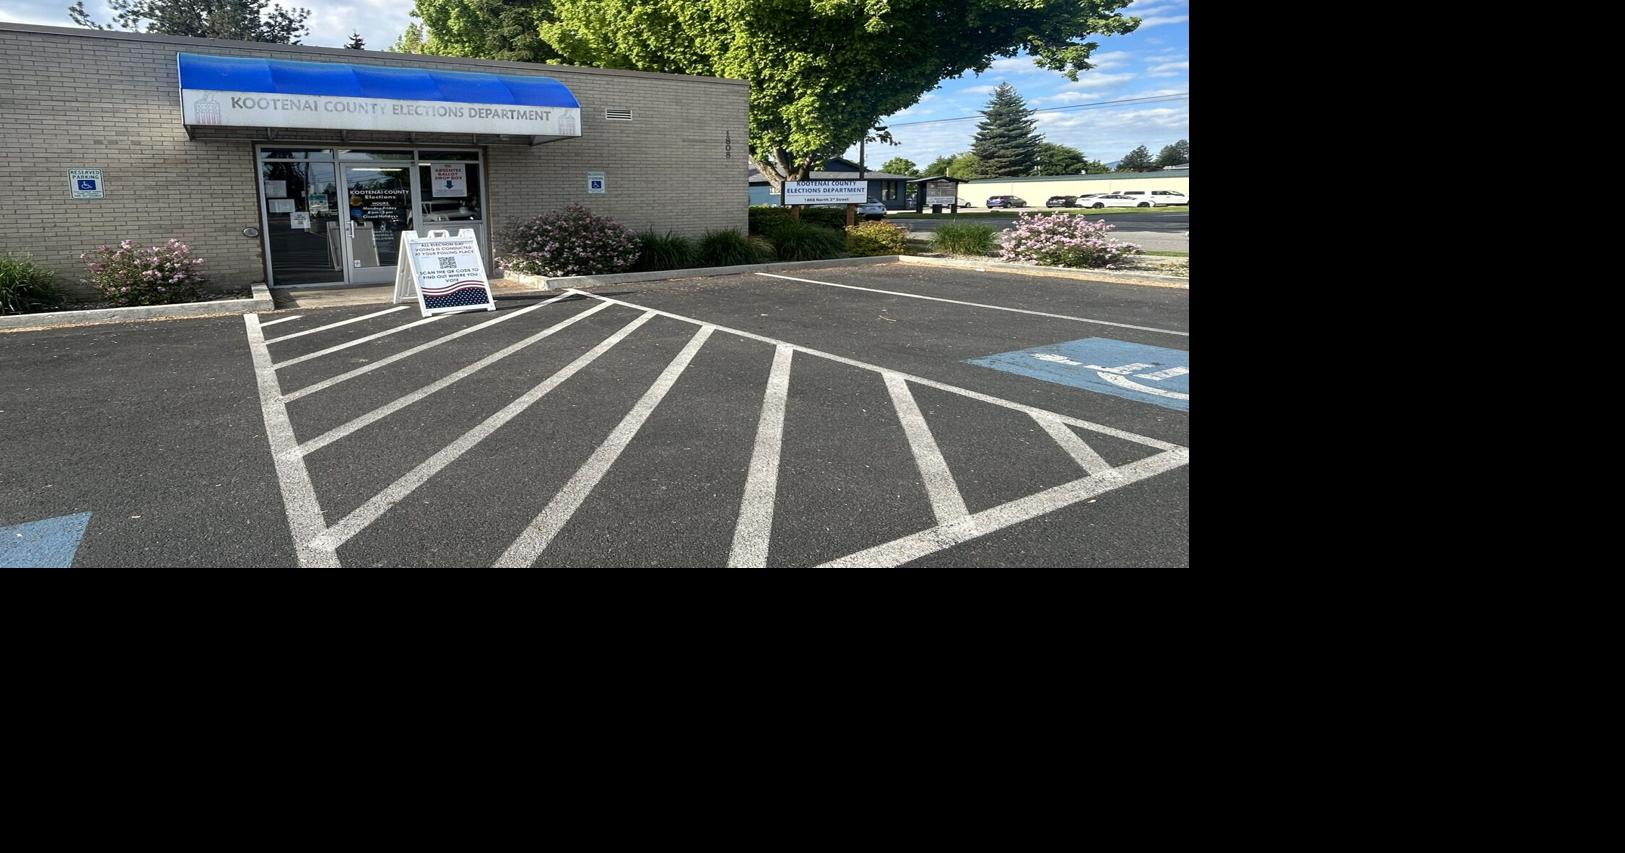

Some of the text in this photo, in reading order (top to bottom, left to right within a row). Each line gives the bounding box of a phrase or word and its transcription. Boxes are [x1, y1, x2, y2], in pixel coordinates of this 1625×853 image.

[231, 96, 552, 121] KOOTENAI COUNTY ELECTIONS DEPARTMENT
